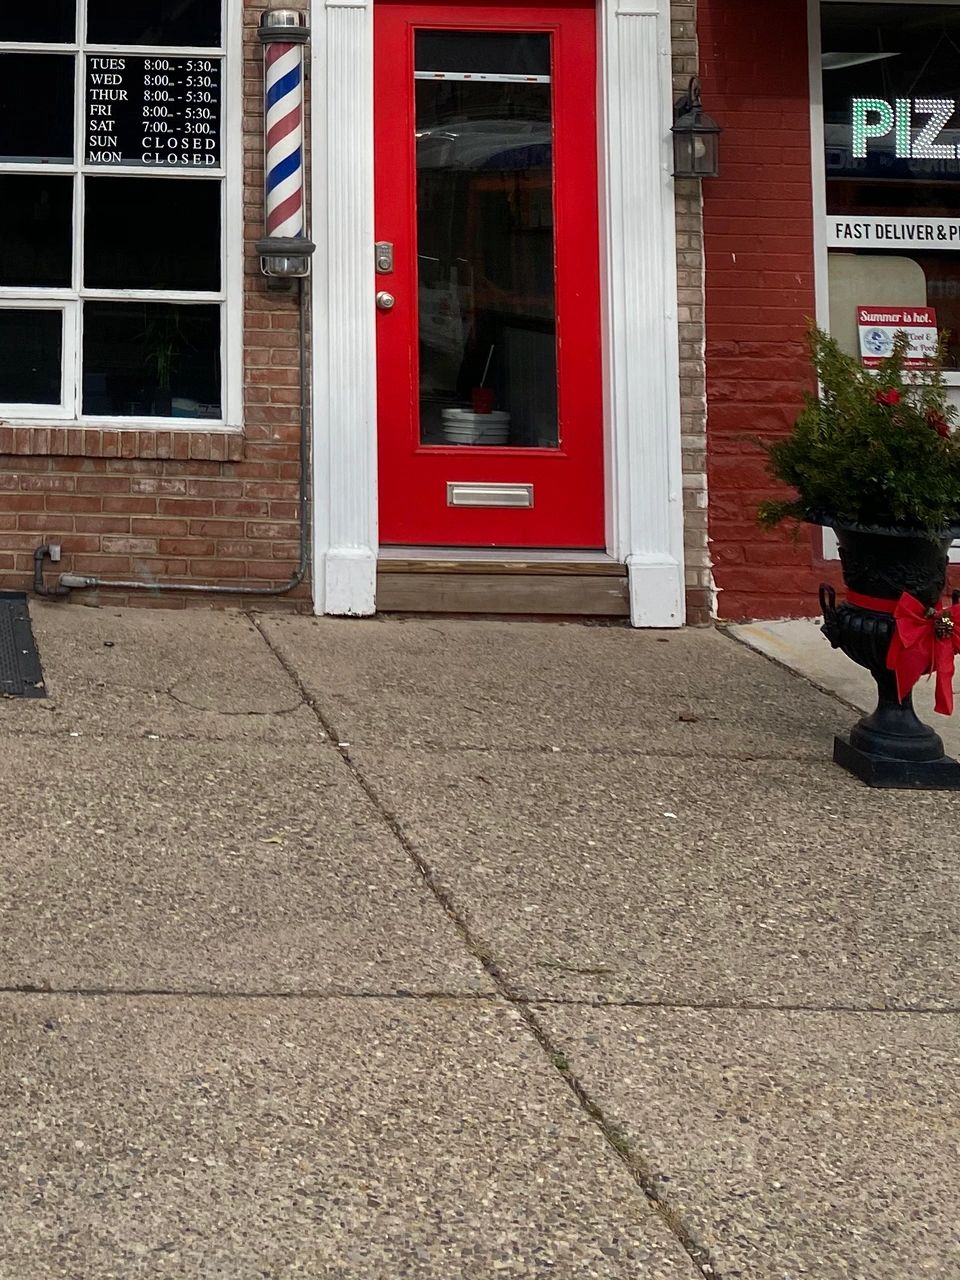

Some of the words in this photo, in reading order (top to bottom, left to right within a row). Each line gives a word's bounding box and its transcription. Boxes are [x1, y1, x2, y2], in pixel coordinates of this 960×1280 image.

[90, 58, 126, 70] TUES
[91, 73, 123, 85] WED
[89, 89, 128, 101] THUR
[90, 104, 112, 116] FRI
[89, 120, 115, 131] SAT
[852, 98, 960, 159] PIZ
[89, 136, 118, 147] SUN
[141, 137, 216, 150] CLOSED
[89, 151, 122, 163] MON
[141, 152, 216, 166] CLOSED
[836, 223, 871, 239] FAST
[875, 224, 934, 241] DELIVER
[937, 224, 947, 241] &
[860, 310, 901, 322] Summer
[903, 311, 912, 323] is
[913, 312, 932, 323] hot.
